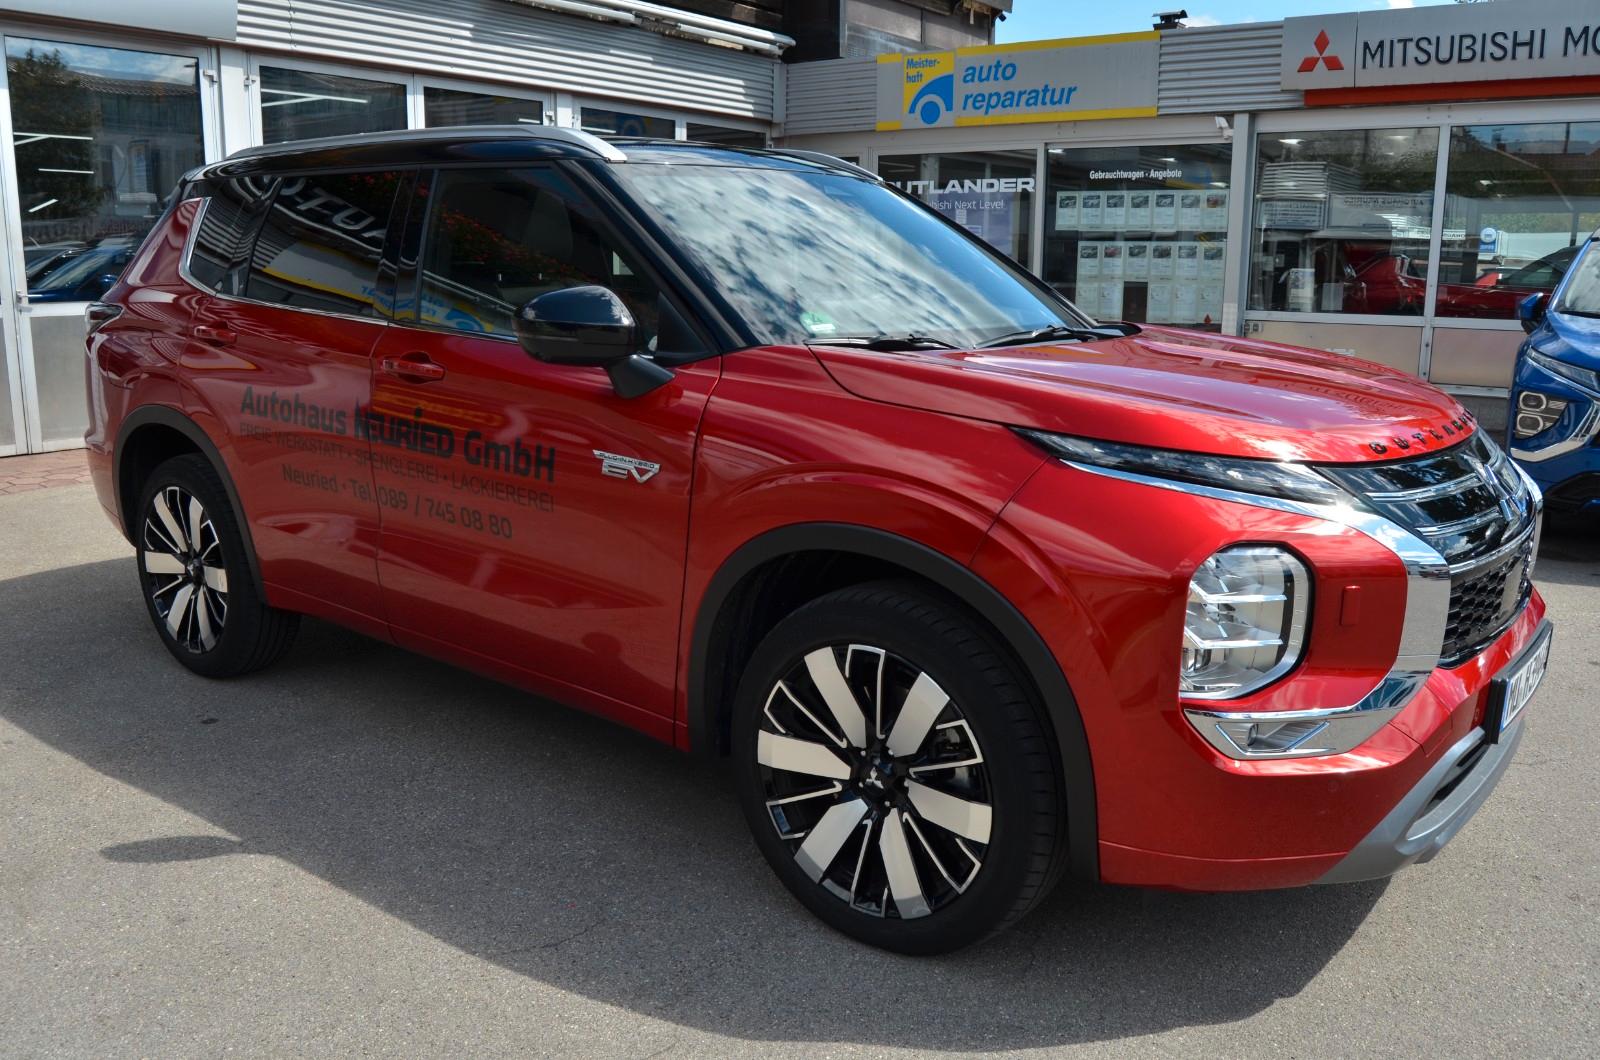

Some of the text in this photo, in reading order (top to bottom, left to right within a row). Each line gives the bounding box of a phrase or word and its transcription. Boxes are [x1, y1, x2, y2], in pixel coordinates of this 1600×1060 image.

[1361, 28, 1546, 69] MITSUBISHI
[906, 71, 923, 83] haft
[962, 59, 1017, 84] auto
[962, 84, 1078, 115] reparatur
[885, 178, 1035, 195] UTLANDER
[1089, 168, 1183, 180] Gebrauchtwagen Angebote
[954, 200, 977, 210] Next
[980, 199, 1004, 210] Level
[240, 385, 347, 435] Autohaus
[463, 430, 556, 483] GmbH
[239, 422, 555, 513] FREIE WERKSTATT SPENGLEREI LACKIEREREI
[281, 463, 339, 493] Neuried
[377, 485, 408, 511] 089
[426, 498, 456, 525] 745
[460, 506, 484, 532] 08
[489, 514, 513, 539] 80
